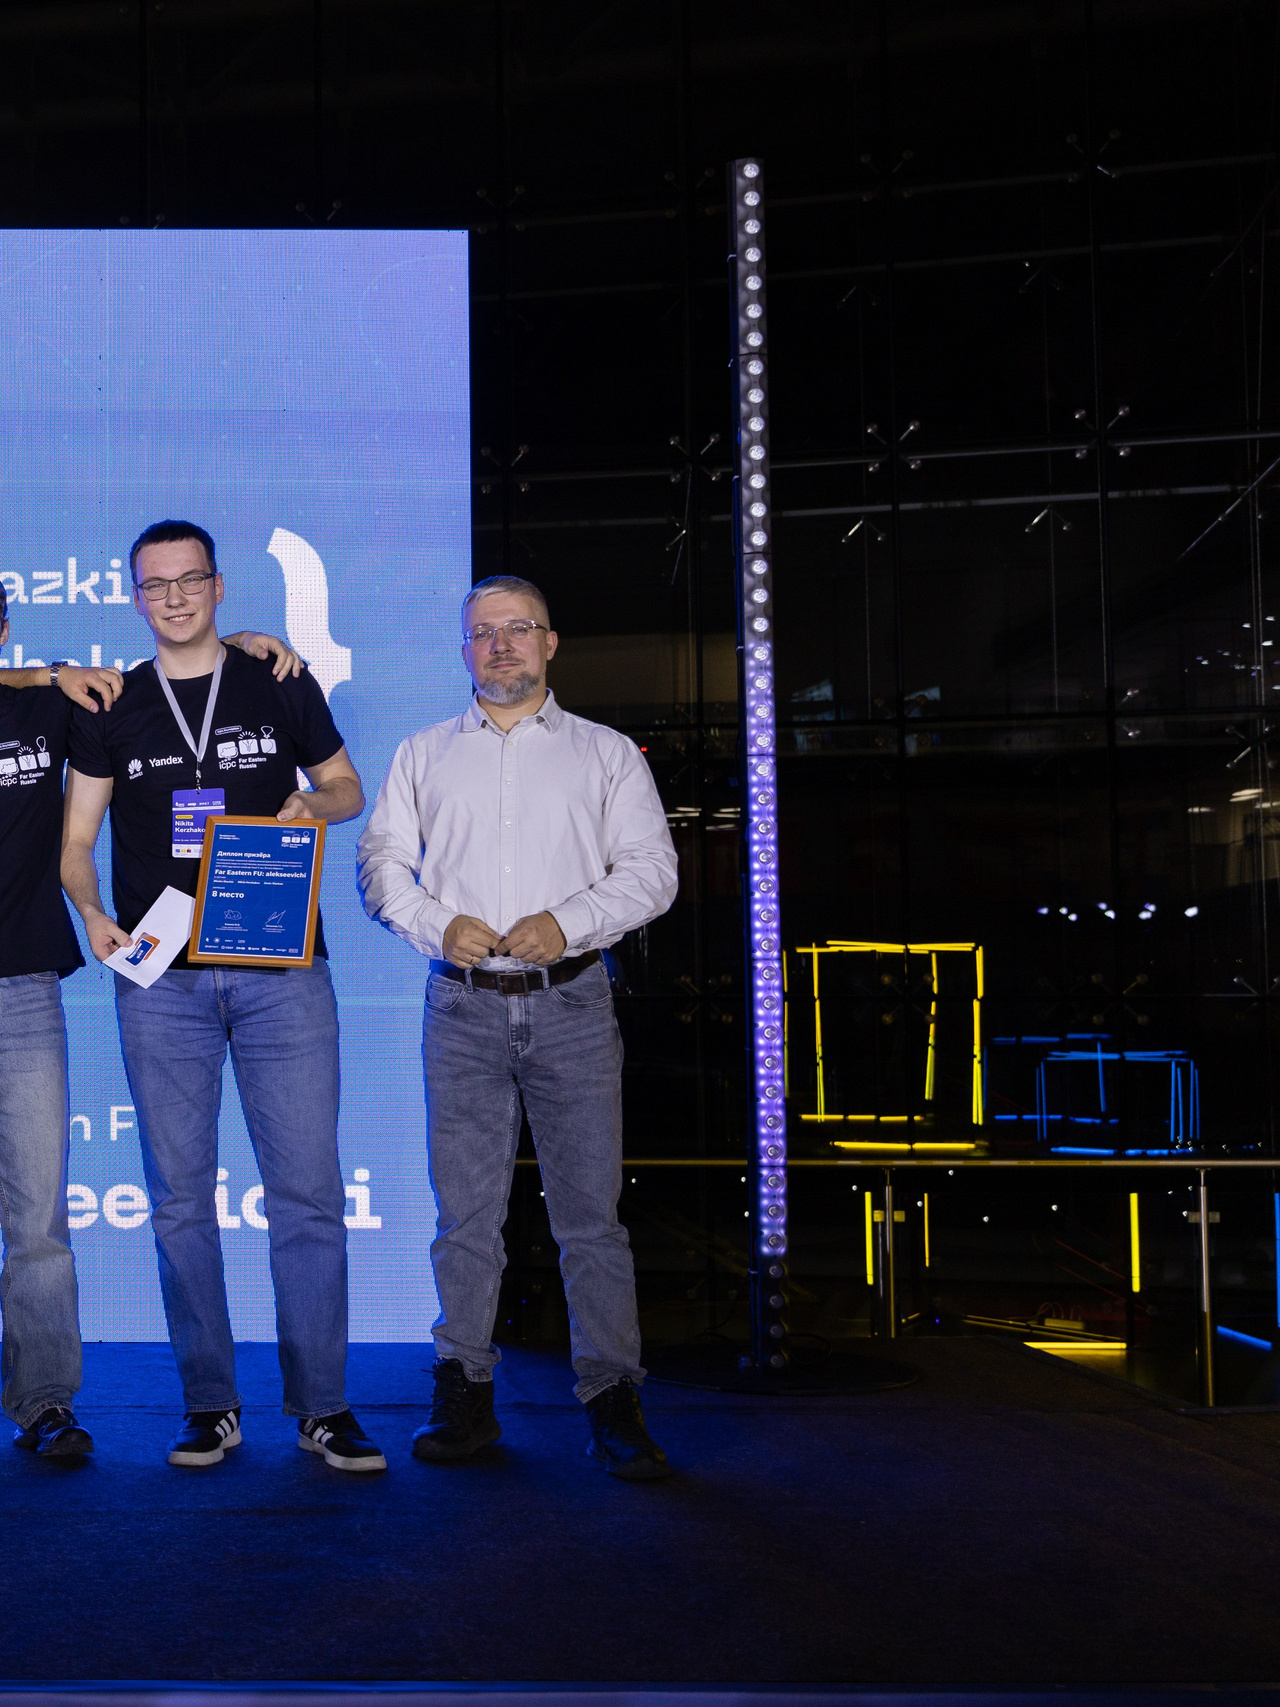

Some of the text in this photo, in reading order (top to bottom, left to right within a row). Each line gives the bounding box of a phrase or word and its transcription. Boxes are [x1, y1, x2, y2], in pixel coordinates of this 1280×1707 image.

[149, 755, 183, 768] Yandex
[219, 759, 237, 770] icpc
[0, 776, 18, 787] icpc
[212, 890, 218, 898] 8
